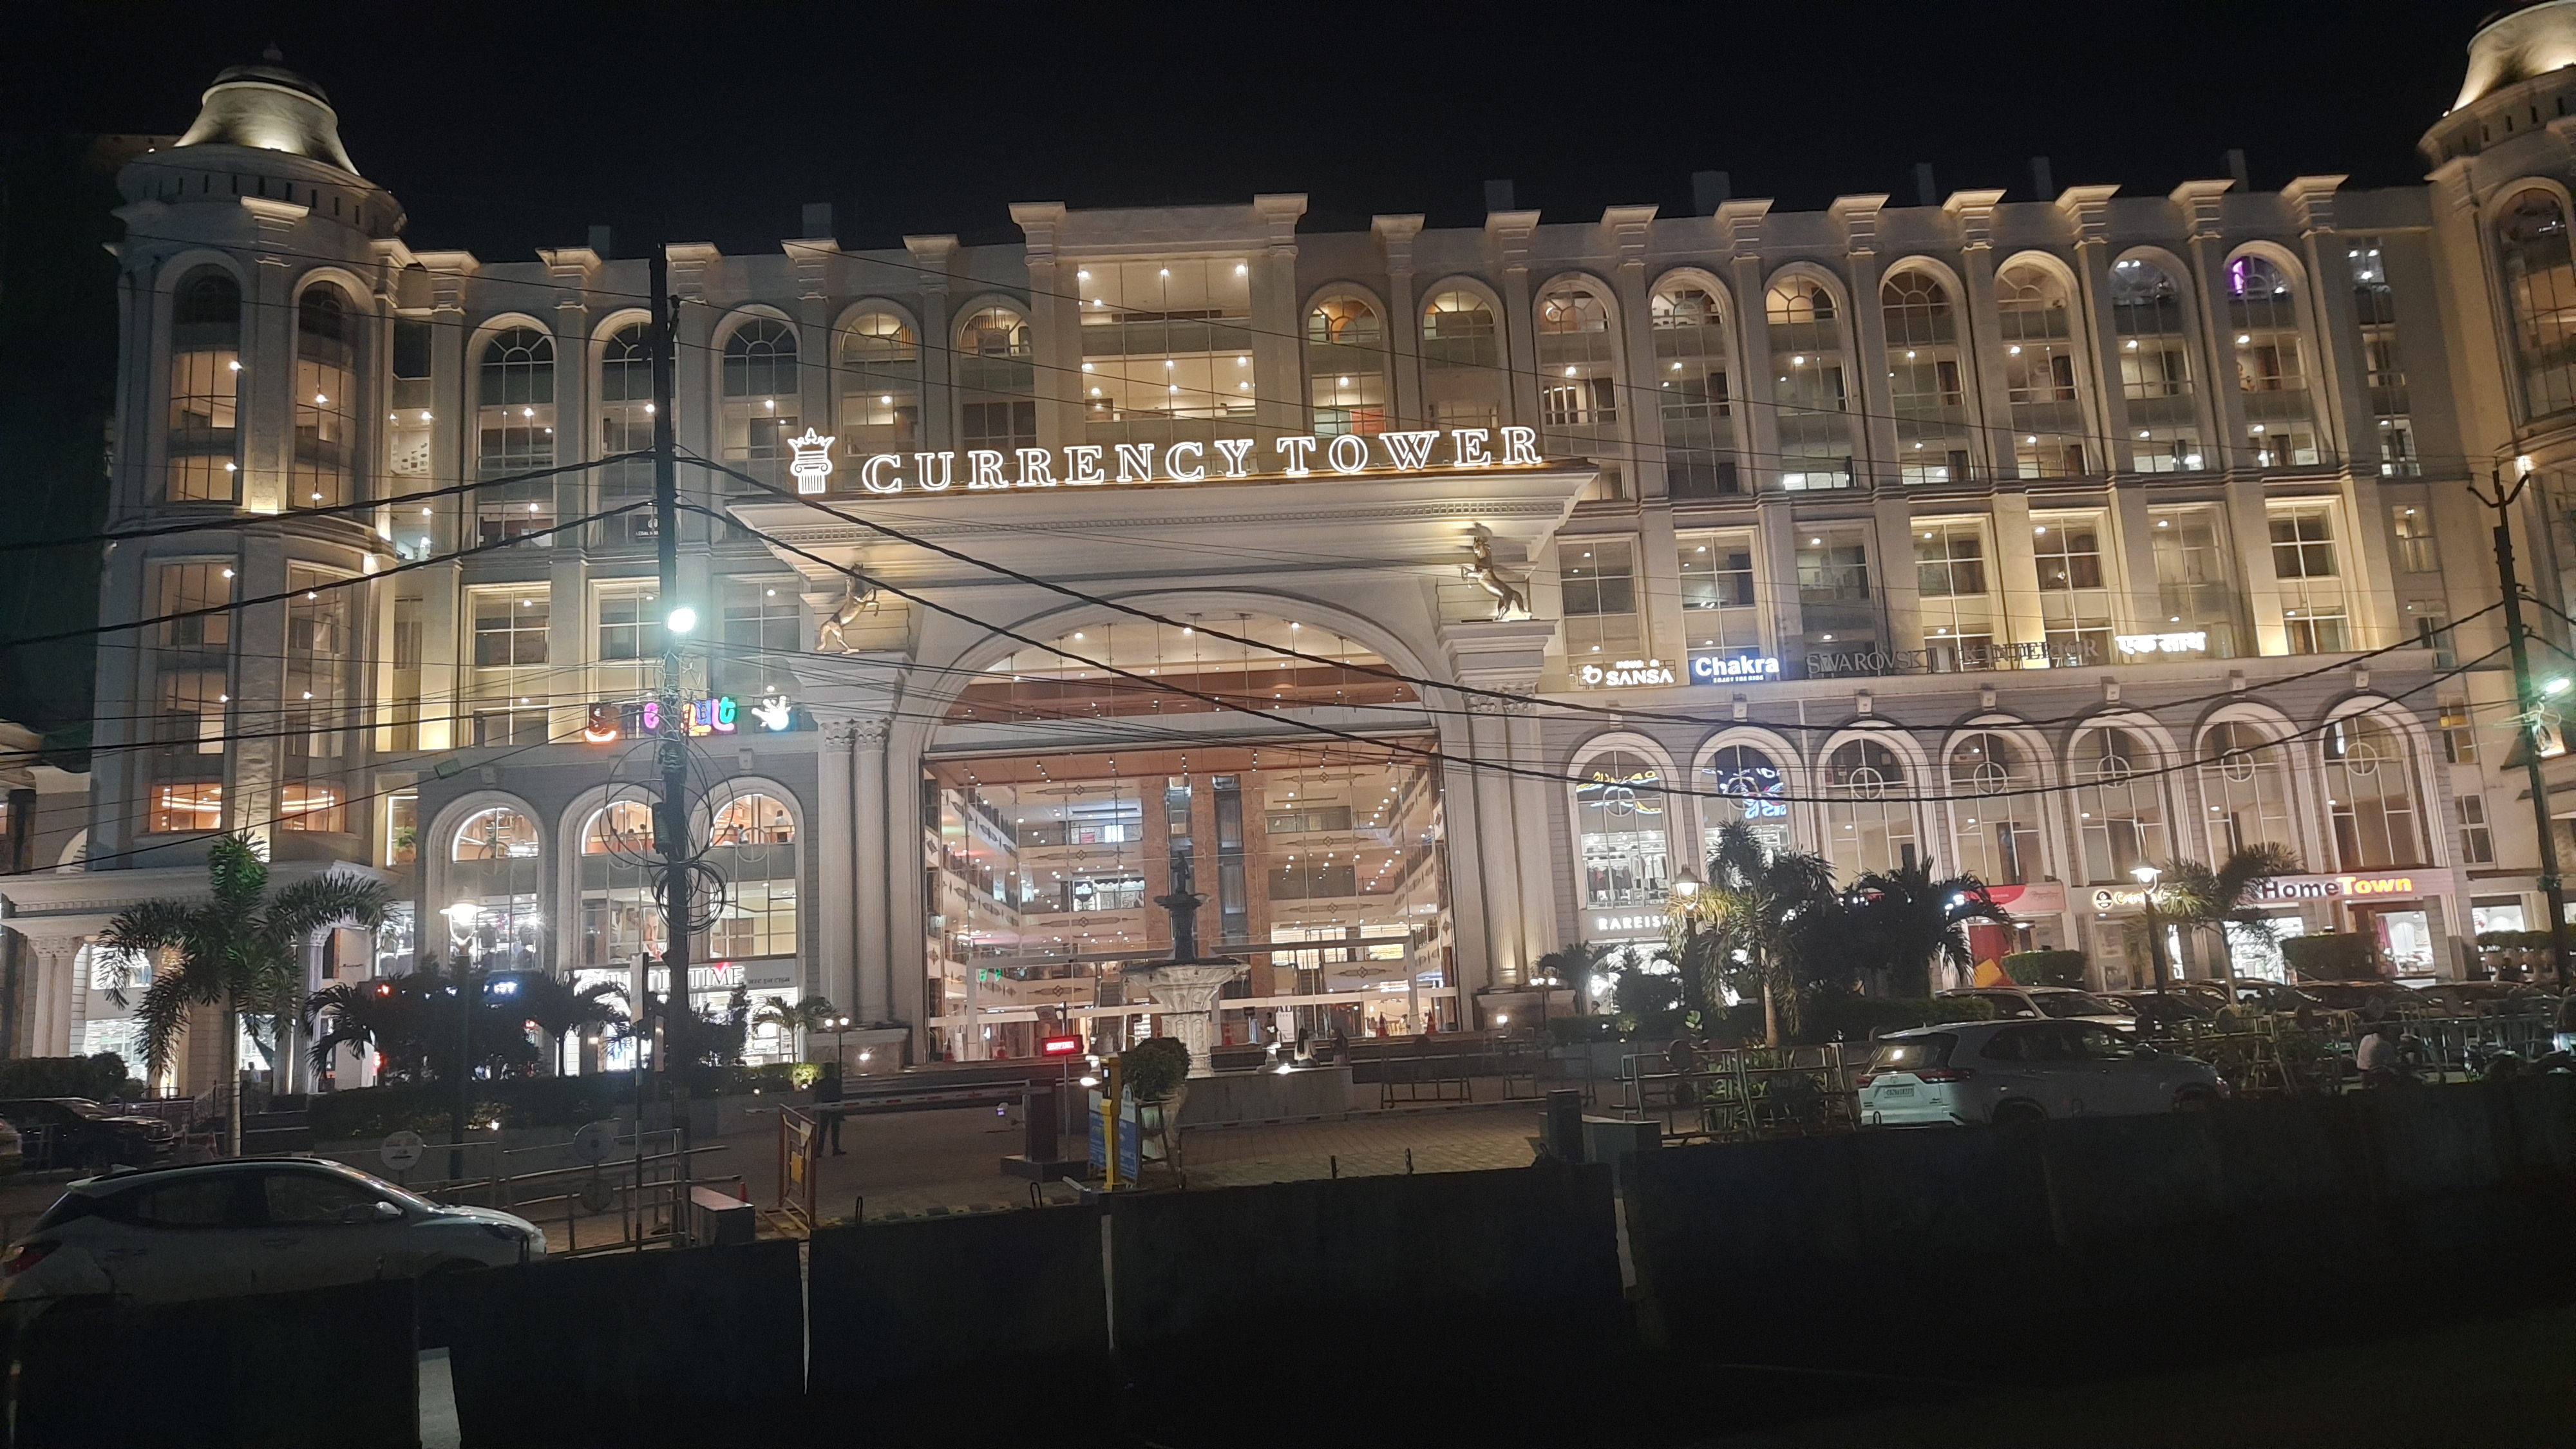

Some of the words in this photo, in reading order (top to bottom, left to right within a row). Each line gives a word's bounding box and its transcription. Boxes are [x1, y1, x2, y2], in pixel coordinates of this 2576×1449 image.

[862, 439, 1255, 494] CURRENCY
[1276, 426, 1542, 477] TOWER
[1695, 655, 1780, 676] Chakra
[1605, 668, 1674, 686] SANSA
[689, 966, 745, 987] TIME
